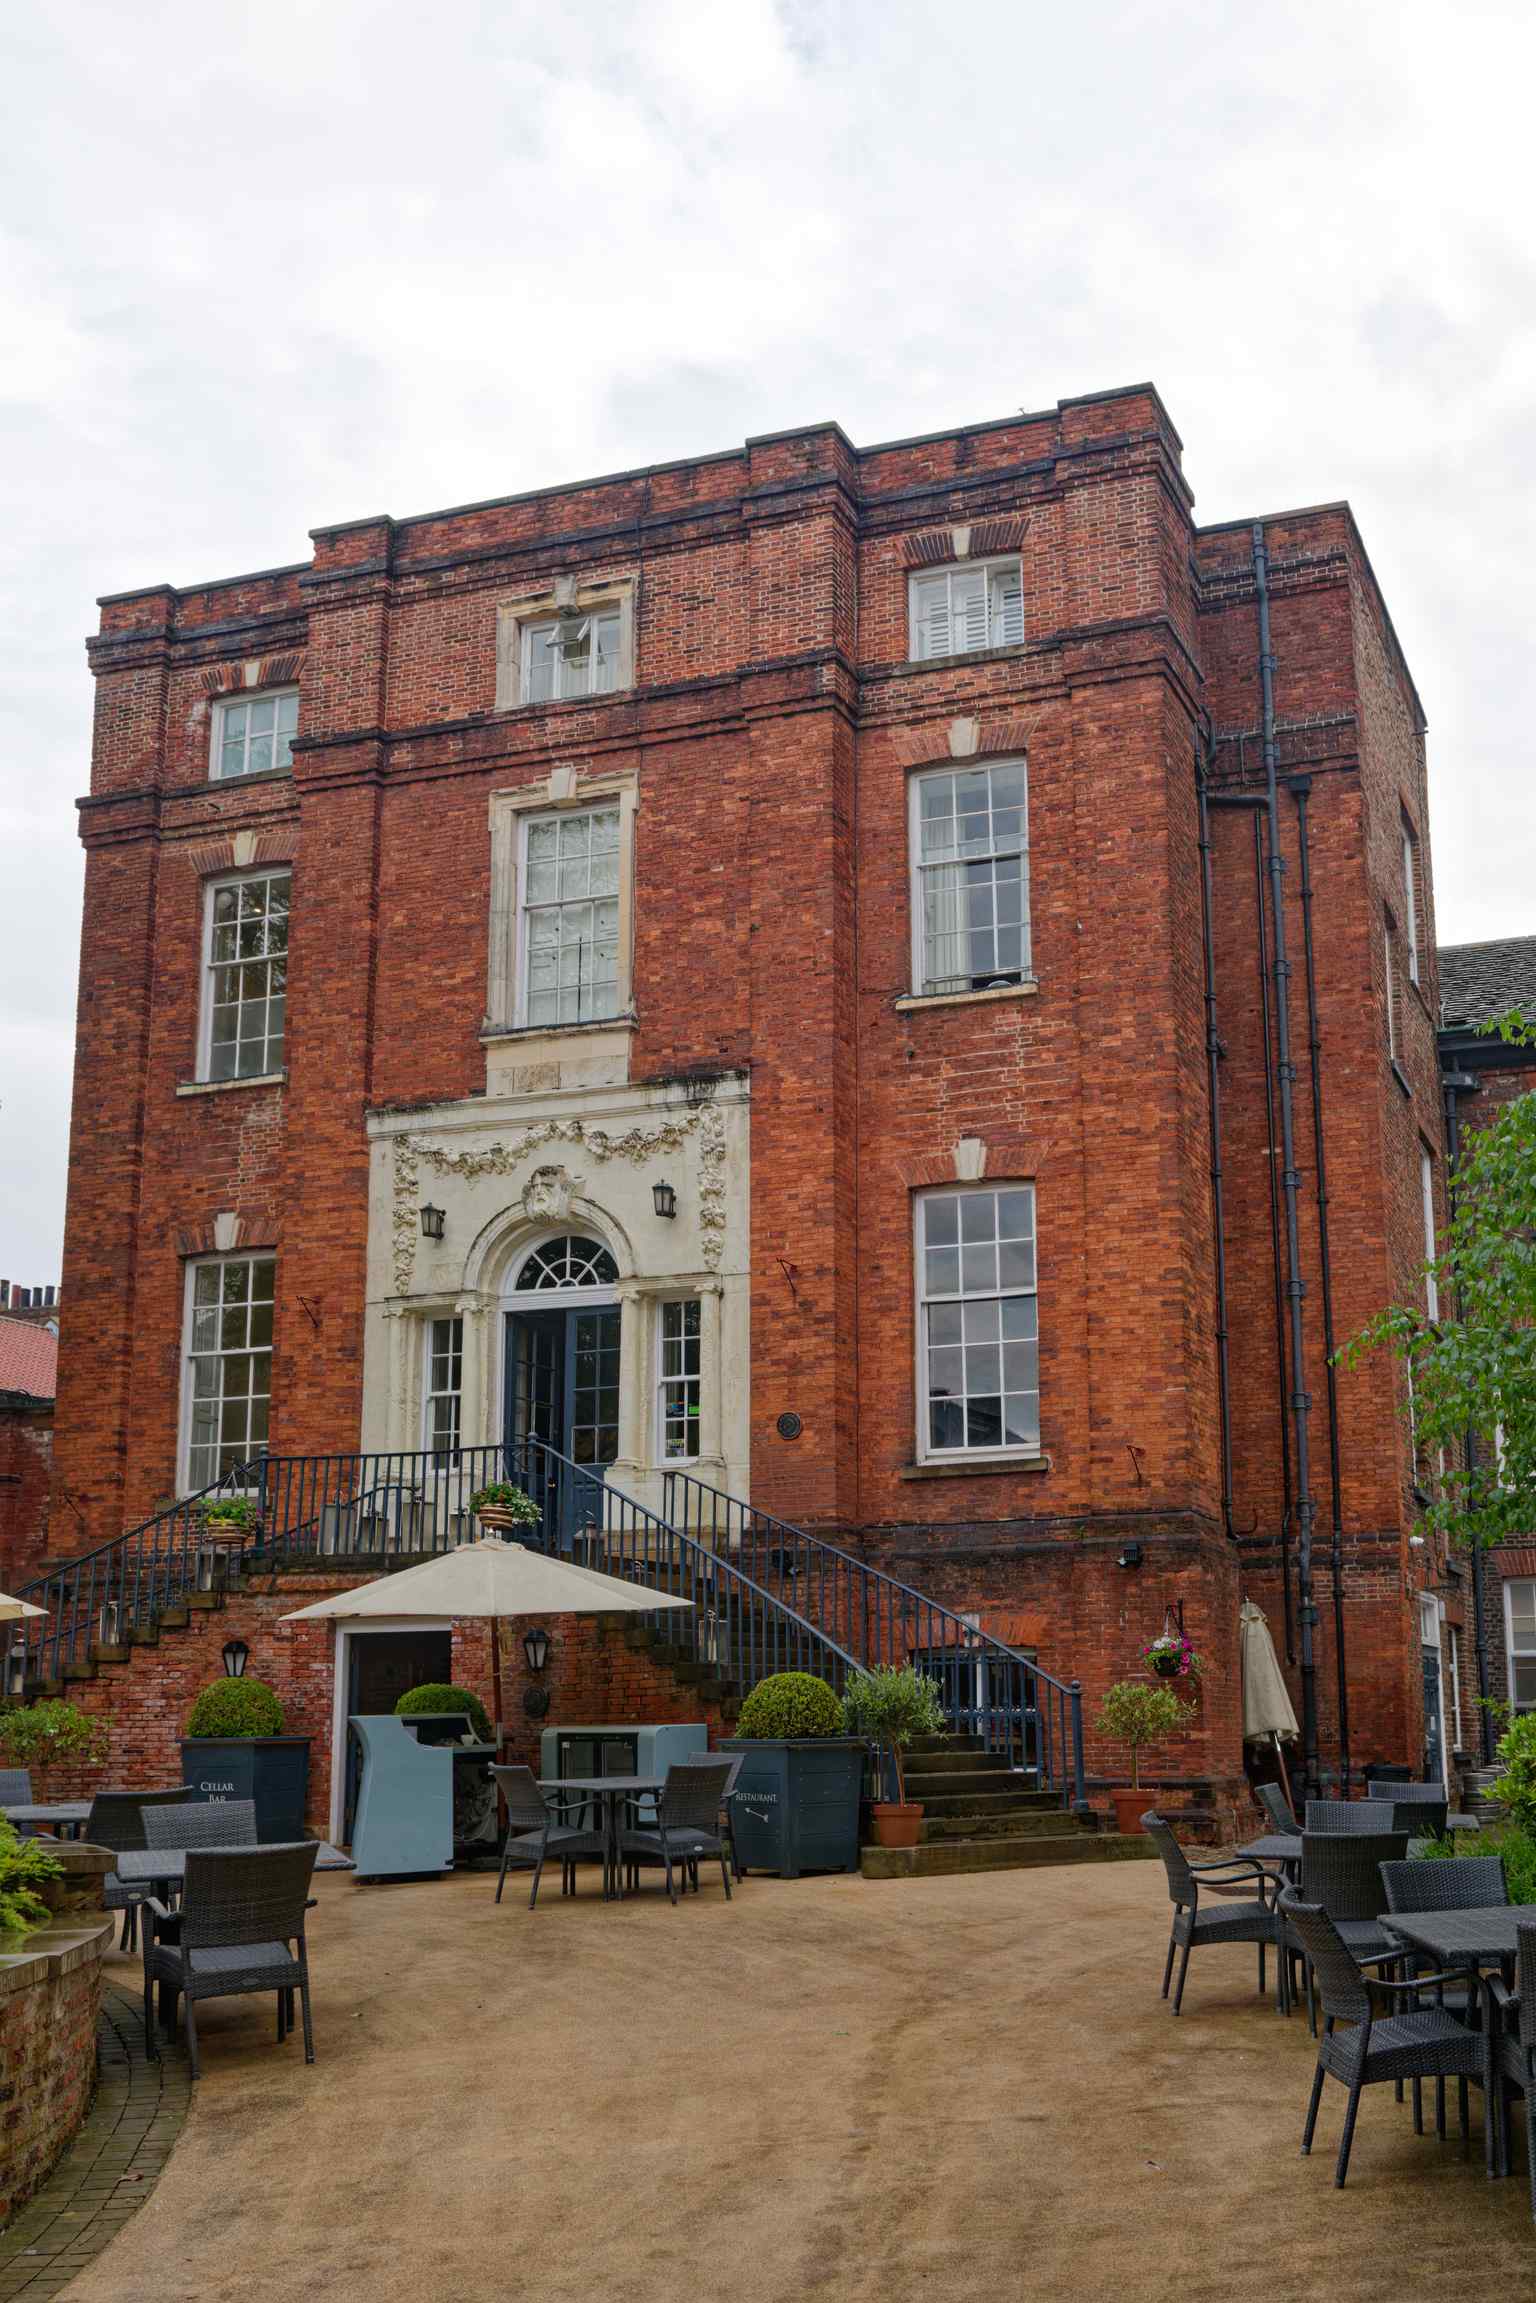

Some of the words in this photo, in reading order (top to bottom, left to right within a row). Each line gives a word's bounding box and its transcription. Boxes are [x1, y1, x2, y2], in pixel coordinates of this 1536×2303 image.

[200, 1781, 234, 1791] CELLAR
[209, 1793, 226, 1804] BAR
[736, 1792, 776, 1802] RESTAURANT
